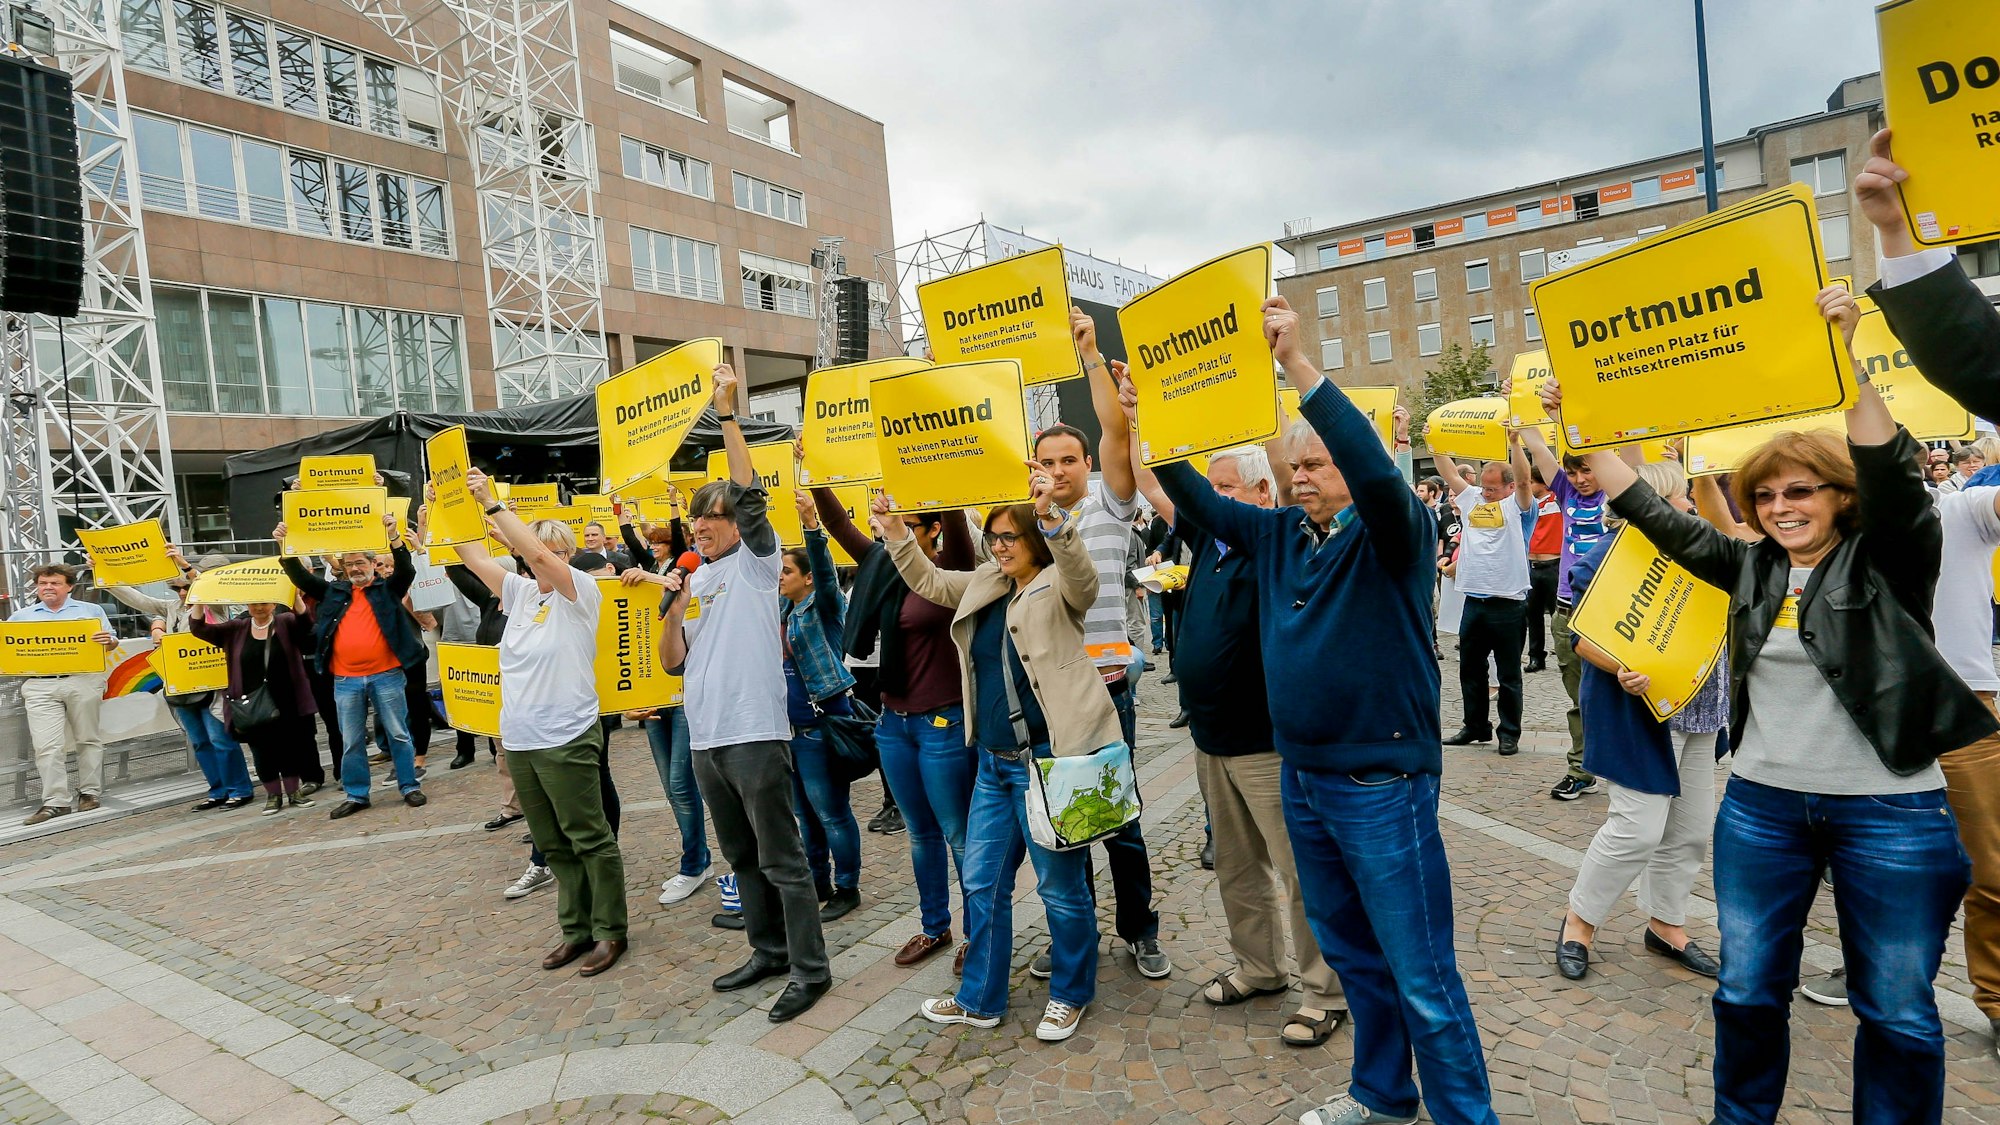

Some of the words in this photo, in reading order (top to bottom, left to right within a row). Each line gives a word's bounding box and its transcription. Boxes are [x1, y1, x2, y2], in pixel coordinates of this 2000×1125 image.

[1664, 176, 1684, 184] Orizon
[943, 286, 1044, 331] Dortmund
[1569, 267, 1764, 349] Dortmund
[959, 335, 972, 345] hat
[972, 329, 998, 341] keinen
[999, 323, 1021, 335] Platz
[1021, 320, 1034, 330] für
[960, 331, 1037, 355] Rechtsextremismus
[1137, 303, 1239, 370] Dortmund
[1594, 355, 1615, 368] hat
[1617, 342, 1665, 363] keinen
[1668, 332, 1709, 351] Platz
[1713, 323, 1739, 340] für
[1161, 377, 1173, 388] hat
[1172, 367, 1198, 384] keinen
[1198, 359, 1219, 374] Platz
[1219, 351, 1232, 366] für
[1597, 340, 1746, 383] Rechtsextremismus
[1162, 368, 1238, 402] Rechtsextremismus
[615, 373, 702, 426] Dortmund
[816, 397, 869, 420] Dortm
[627, 428, 638, 438] hat
[639, 419, 662, 433] keinen
[663, 411, 680, 424] Platz
[681, 407, 691, 416] für
[880, 397, 993, 438] Dortmund
[1440, 409, 1497, 420] Dortmund
[627, 416, 691, 448] Rechtsextremismus
[838, 424, 861, 433] keinen
[862, 421, 874, 429] Pla
[897, 446, 911, 455] hat
[911, 441, 940, 452] keinen
[940, 437, 964, 448] Platz
[964, 434, 979, 445] für
[900, 447, 984, 466] Rechtsextremismus
[309, 467, 364, 477] Dortmund
[298, 503, 371, 518] Dortmund
[511, 494, 549, 503] ortmund
[91, 538, 150, 554] Dortmund
[1647, 630, 1658, 645] hat
[1653, 605, 1670, 631] keinen
[1664, 586, 1679, 606] Platz
[1675, 574, 1685, 588] für
[1656, 581, 1695, 654] Rechtsextremismus
[5, 634, 87, 645] Dortmund
[614, 598, 632, 692] Dortmund
[644, 607, 652, 678] Rechtsextremismus
[178, 645, 226, 659] Dortm
[448, 666, 500, 686] Dortmund
[454, 694, 496, 705] Rechtsextremismus
[461, 688, 475, 696] keinen
[475, 689, 487, 697] Platz
